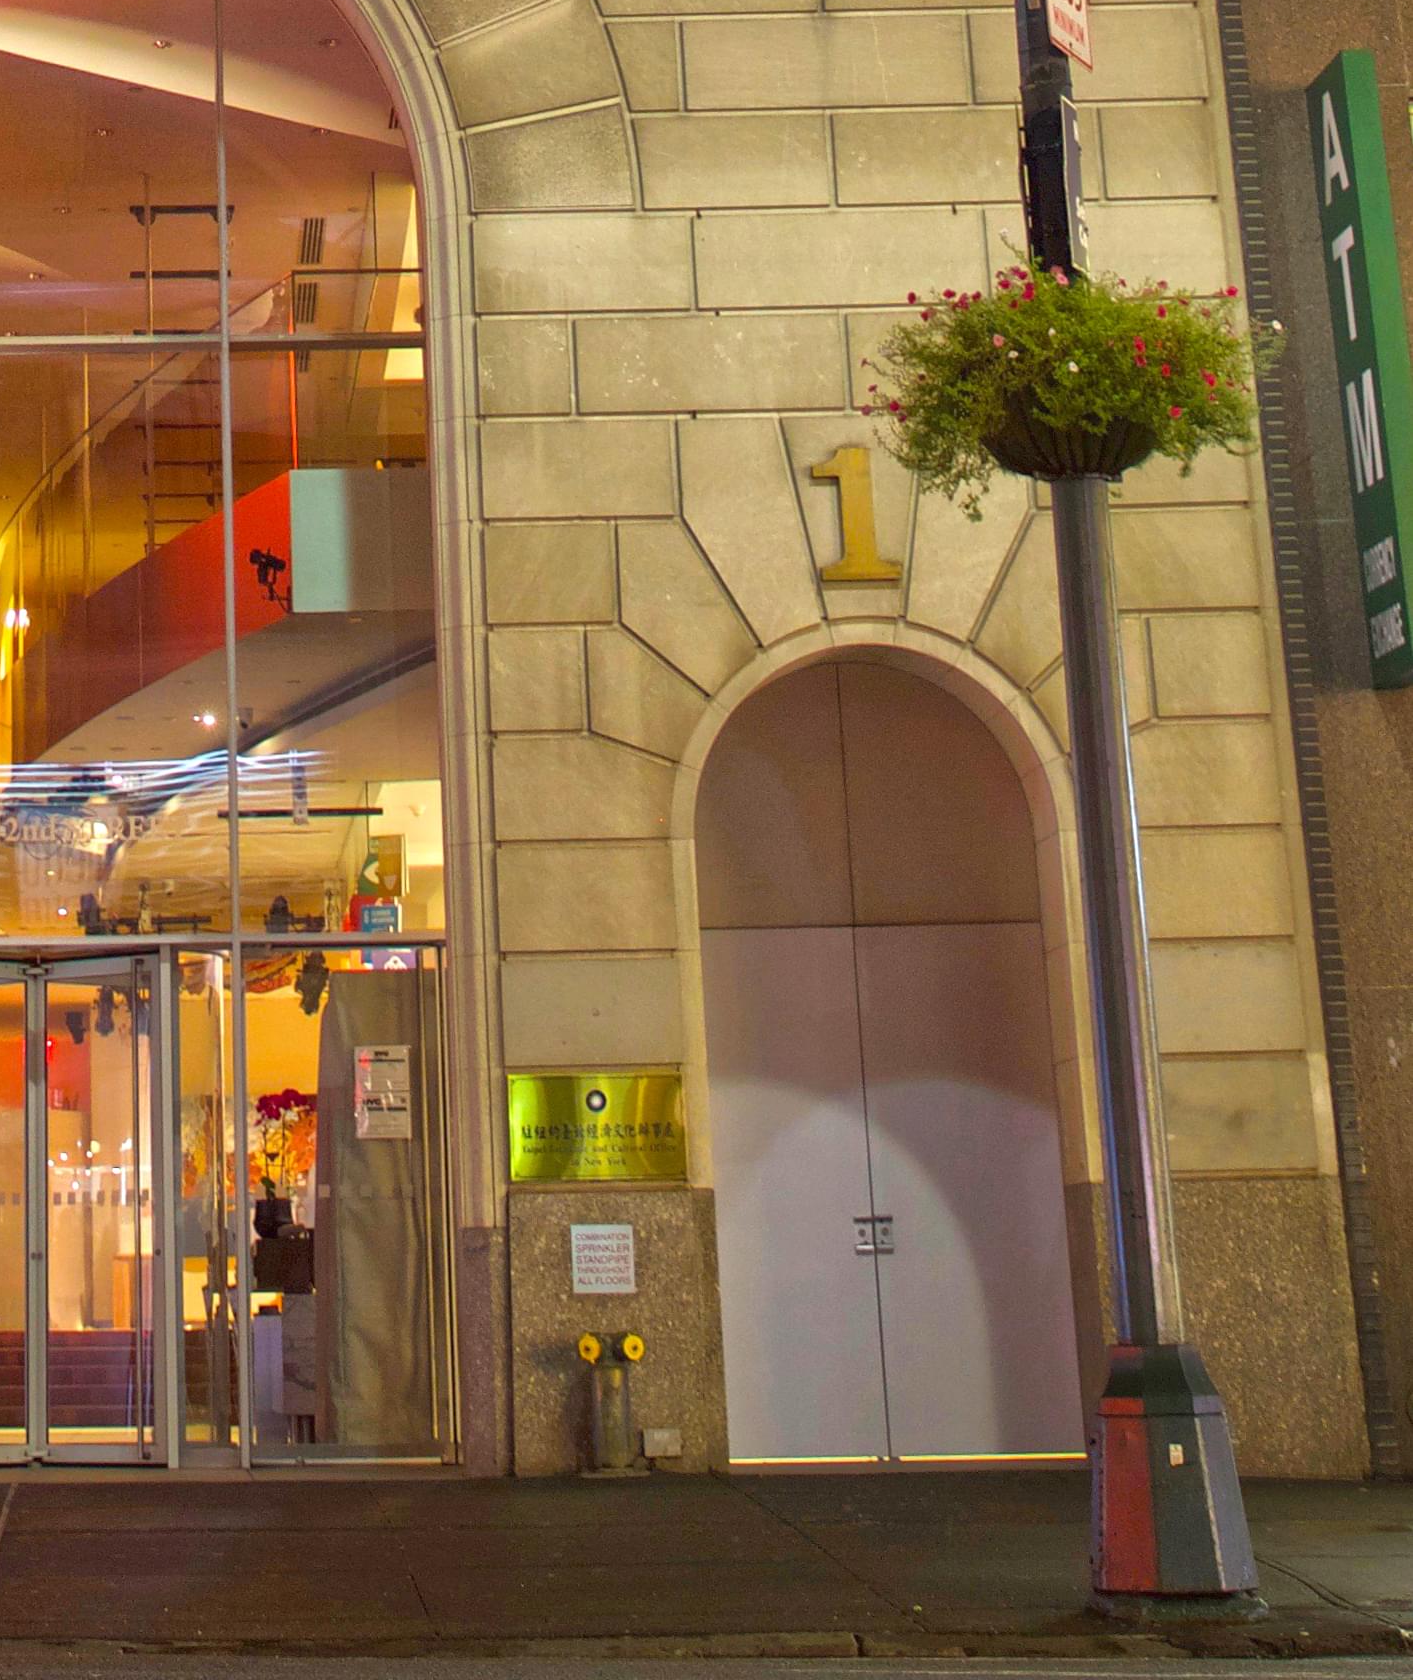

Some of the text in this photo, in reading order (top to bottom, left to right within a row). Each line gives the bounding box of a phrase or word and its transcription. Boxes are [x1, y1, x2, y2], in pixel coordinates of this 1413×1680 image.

[1052, 4, 1086, 48] MINIMUM
[1322, 89, 1385, 494] ATM
[811, 446, 903, 581] 1
[607, 1157, 627, 1166] York
[577, 1243, 630, 1253] SPRINKLER
[577, 1254, 630, 1264] STANDPIPE
[578, 1275, 631, 1285] ALL FLOORS
